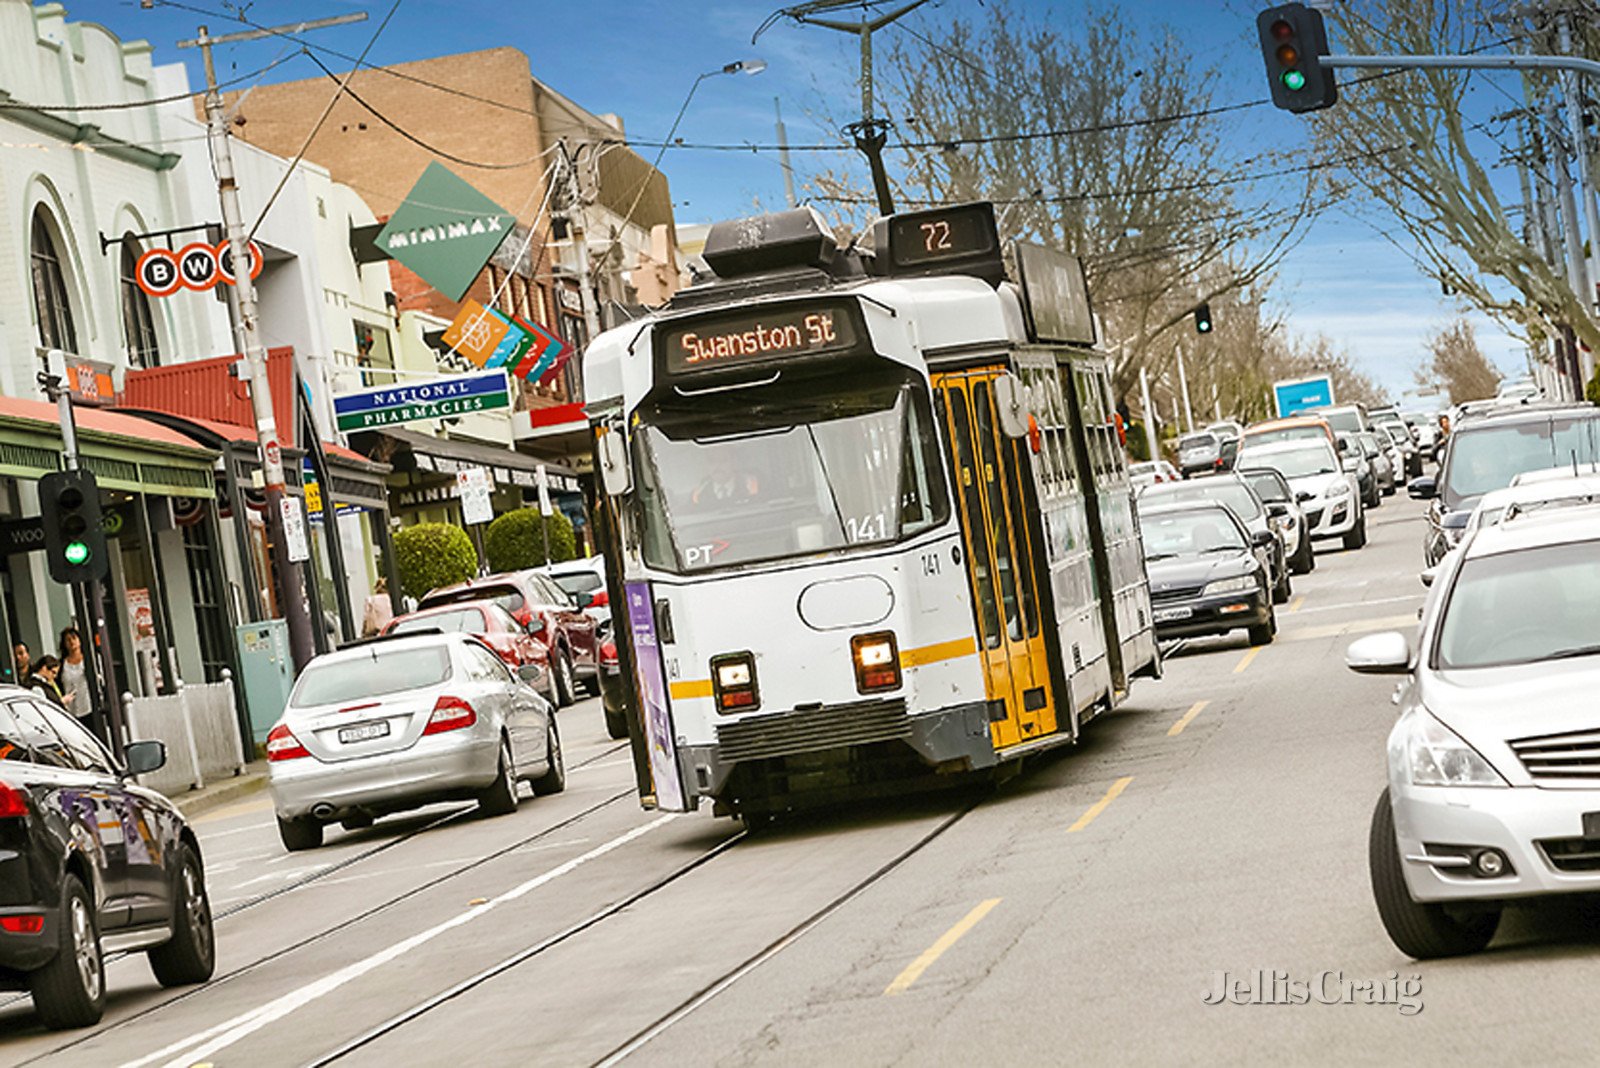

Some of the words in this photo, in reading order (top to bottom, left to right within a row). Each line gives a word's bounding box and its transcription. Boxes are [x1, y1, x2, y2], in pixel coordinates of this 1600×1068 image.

[388, 216, 501, 248] MINIMAX
[920, 221, 952, 251] 72
[681, 324, 801, 363] Swanston
[804, 314, 836, 344] St
[373, 381, 469, 405] NATIONAL
[363, 397, 483, 426] PHARMACIES
[847, 513, 886, 543] 141
[685, 544, 714, 567] PT
[921, 553, 941, 577] 141
